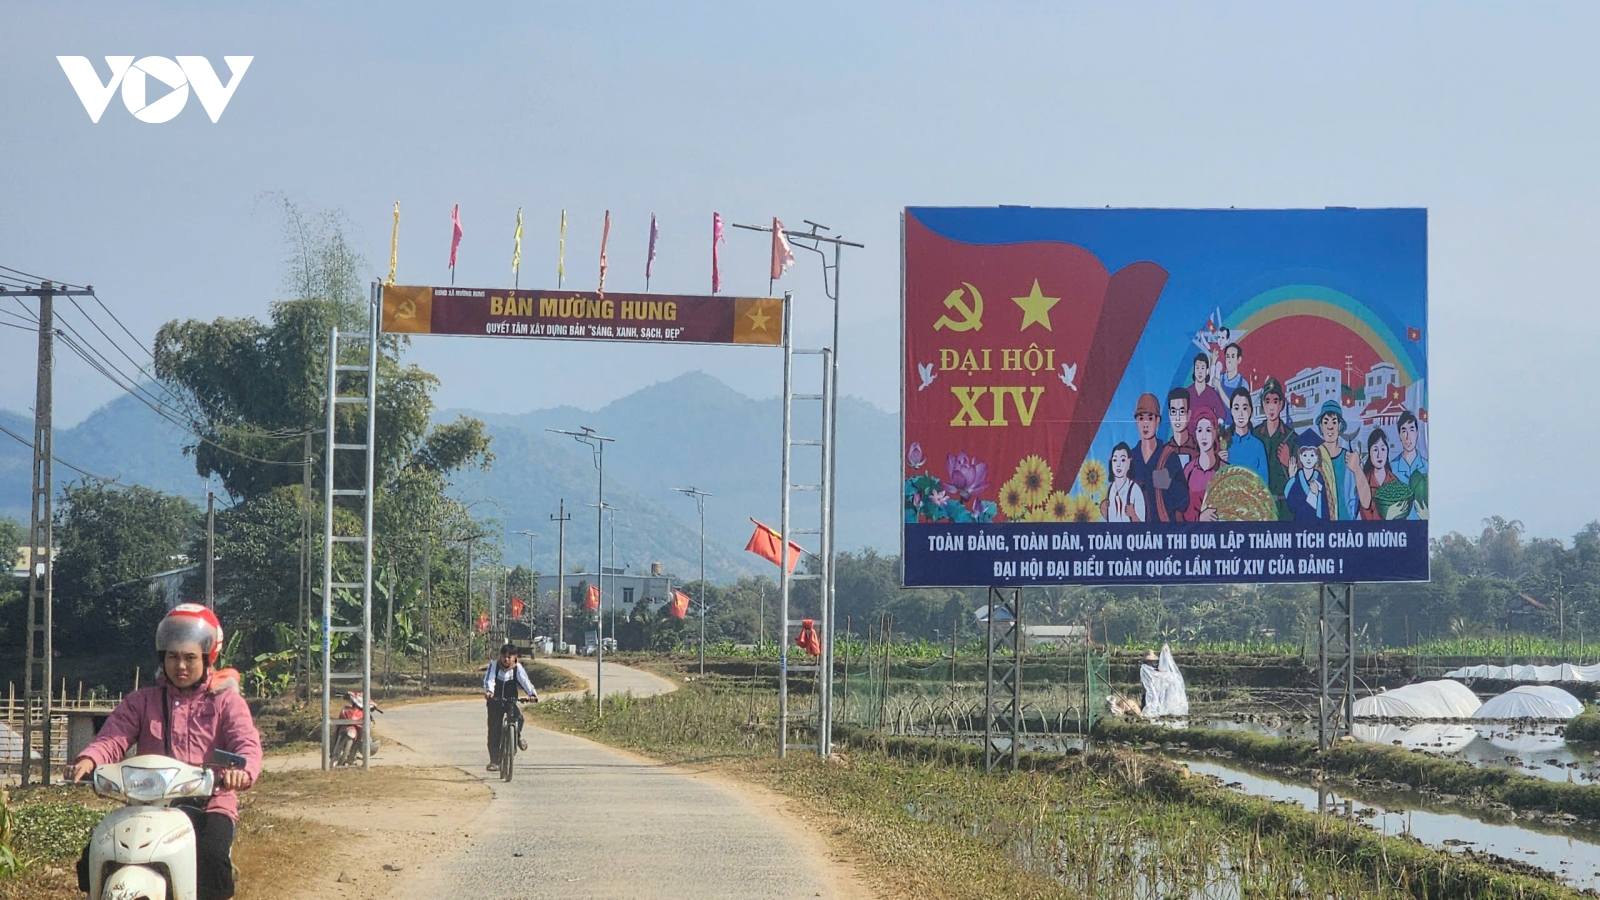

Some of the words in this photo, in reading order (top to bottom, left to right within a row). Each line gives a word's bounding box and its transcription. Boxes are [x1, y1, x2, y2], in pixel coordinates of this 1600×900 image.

[490, 291, 533, 317] BẢN
[540, 293, 615, 320] MƯỜNG
[621, 300, 677, 321] HUNG
[486, 320, 510, 335] QUYẾT
[512, 322, 528, 335] TÂM
[529, 322, 545, 336] XÂY
[547, 324, 568, 337] DỰNG
[569, 322, 586, 336] BẢN
[616, 326, 639, 339] XANH,
[641, 327, 663, 340] SẠCH,
[939, 348, 992, 377] ĐẠI
[1001, 342, 1056, 377] HỘI
[950, 386, 1045, 427] XIV
[928, 532, 964, 551] TOÀN
[967, 530, 1010, 553] ĐẢNG,
[1013, 531, 1048, 550] TOÀN
[1052, 531, 1084, 552] DÂN,
[1088, 531, 1123, 550] TOÀN
[1126, 530, 1163, 551] QUÂN
[1166, 534, 1187, 550] THI
[1190, 533, 1217, 549] ĐUA
[1220, 530, 1245, 552] LẬP
[1249, 530, 1292, 549] THÀNH
[1295, 530, 1325, 549] TÍCH
[1328, 529, 1364, 548] CHÀO
[1367, 529, 1408, 548] MỪNG
[993, 561, 1016, 581] ĐẠI
[1020, 558, 1043, 580] HỘI
[1047, 560, 1070, 580] ĐẠI
[1073, 554, 1104, 577] BIỂU
[1107, 557, 1142, 577] TOÀN
[1146, 554, 1182, 578] QUỐC
[1185, 554, 1211, 576] LẦN
[1214, 556, 1241, 576] THỨ
[1243, 559, 1265, 575] XIV
[1268, 554, 1295, 575] CỦA
[1298, 553, 1335, 574] ĐẢNG
